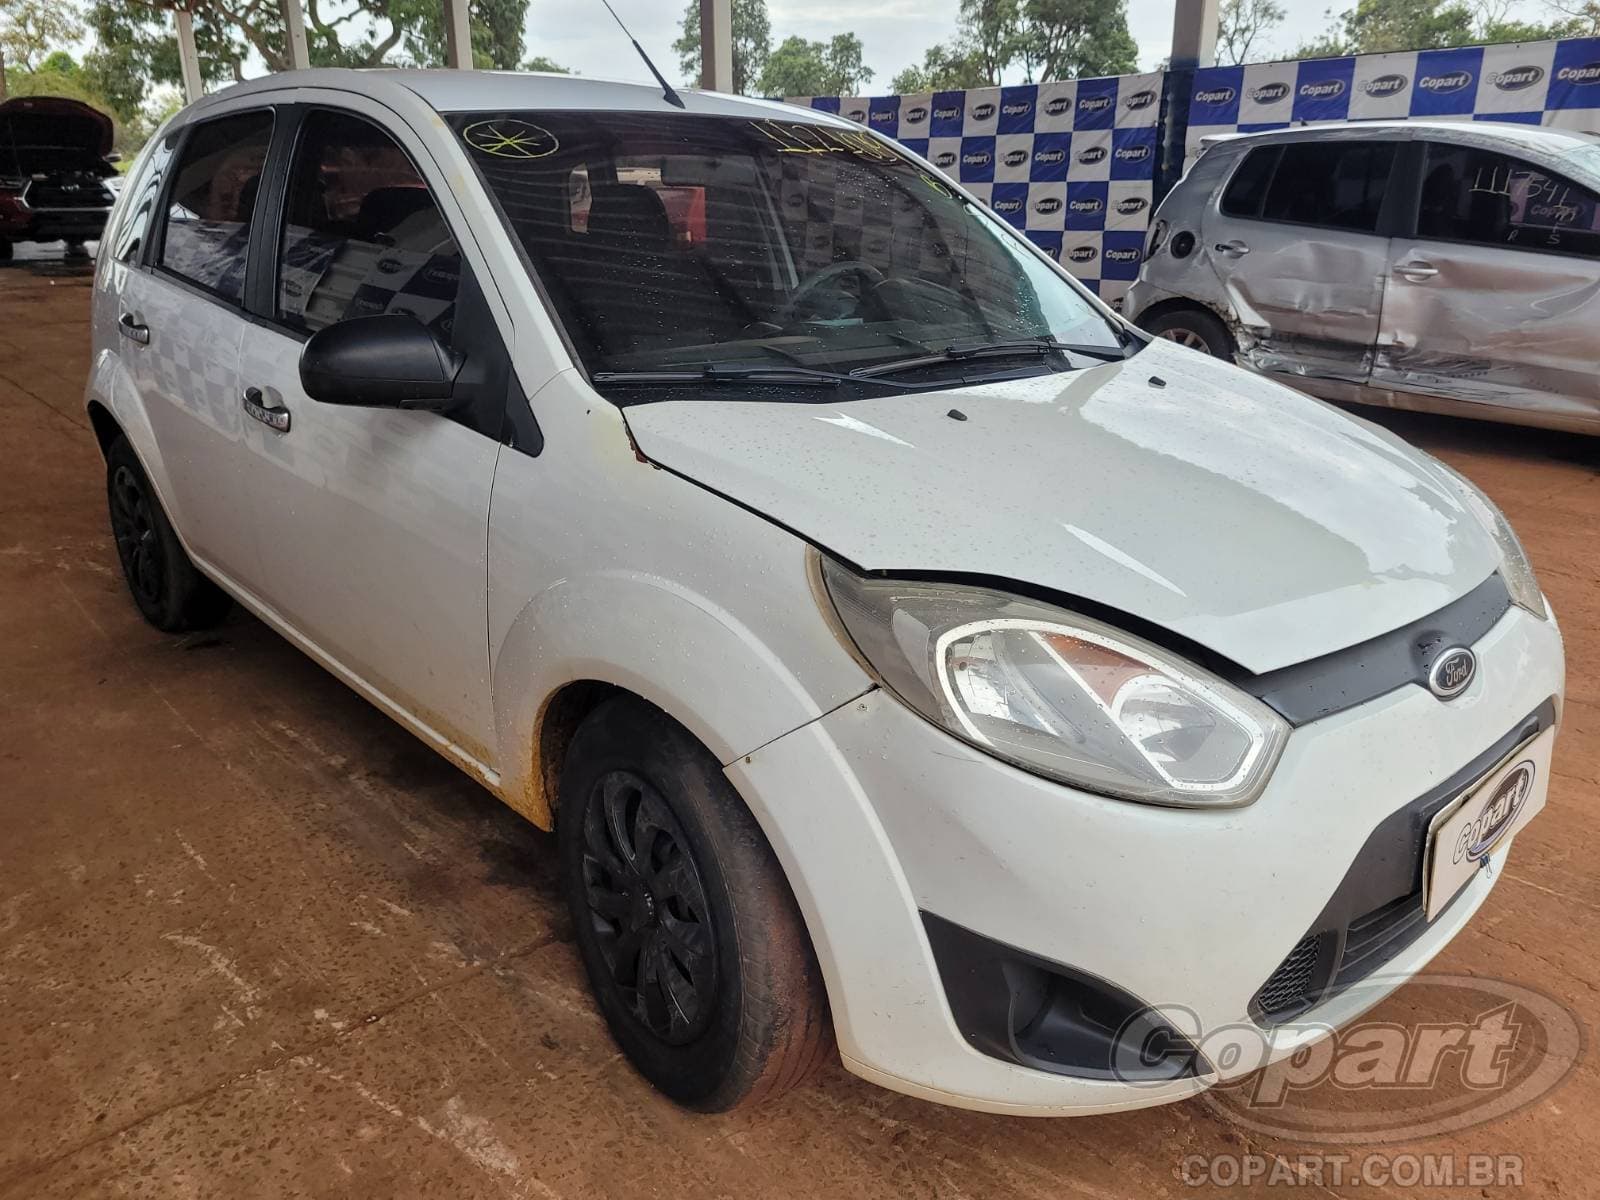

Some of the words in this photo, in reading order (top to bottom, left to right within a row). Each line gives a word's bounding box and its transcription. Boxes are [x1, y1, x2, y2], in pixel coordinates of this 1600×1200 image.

[1486, 69, 1535, 86] Copart
[1557, 66, 1600, 82] Copar
[1358, 75, 1400, 91] Copart
[1419, 73, 1467, 89] Copart
[1195, 89, 1230, 103] Copart
[1247, 87, 1285, 101] Copart
[1300, 83, 1341, 98] Copart
[1002, 104, 1029, 115] Copart
[1079, 97, 1109, 109] Copart
[933, 109, 958, 120] Copart
[963, 155, 988, 164] Copart
[1035, 151, 1061, 163] Copart
[1115, 148, 1147, 160] Copart
[994, 201, 1020, 212] Copart
[1070, 200, 1099, 211] Copart
[1106, 249, 1137, 260] Copart
[1445, 657, 1469, 688] Ford
[1453, 766, 1526, 866] Copart
